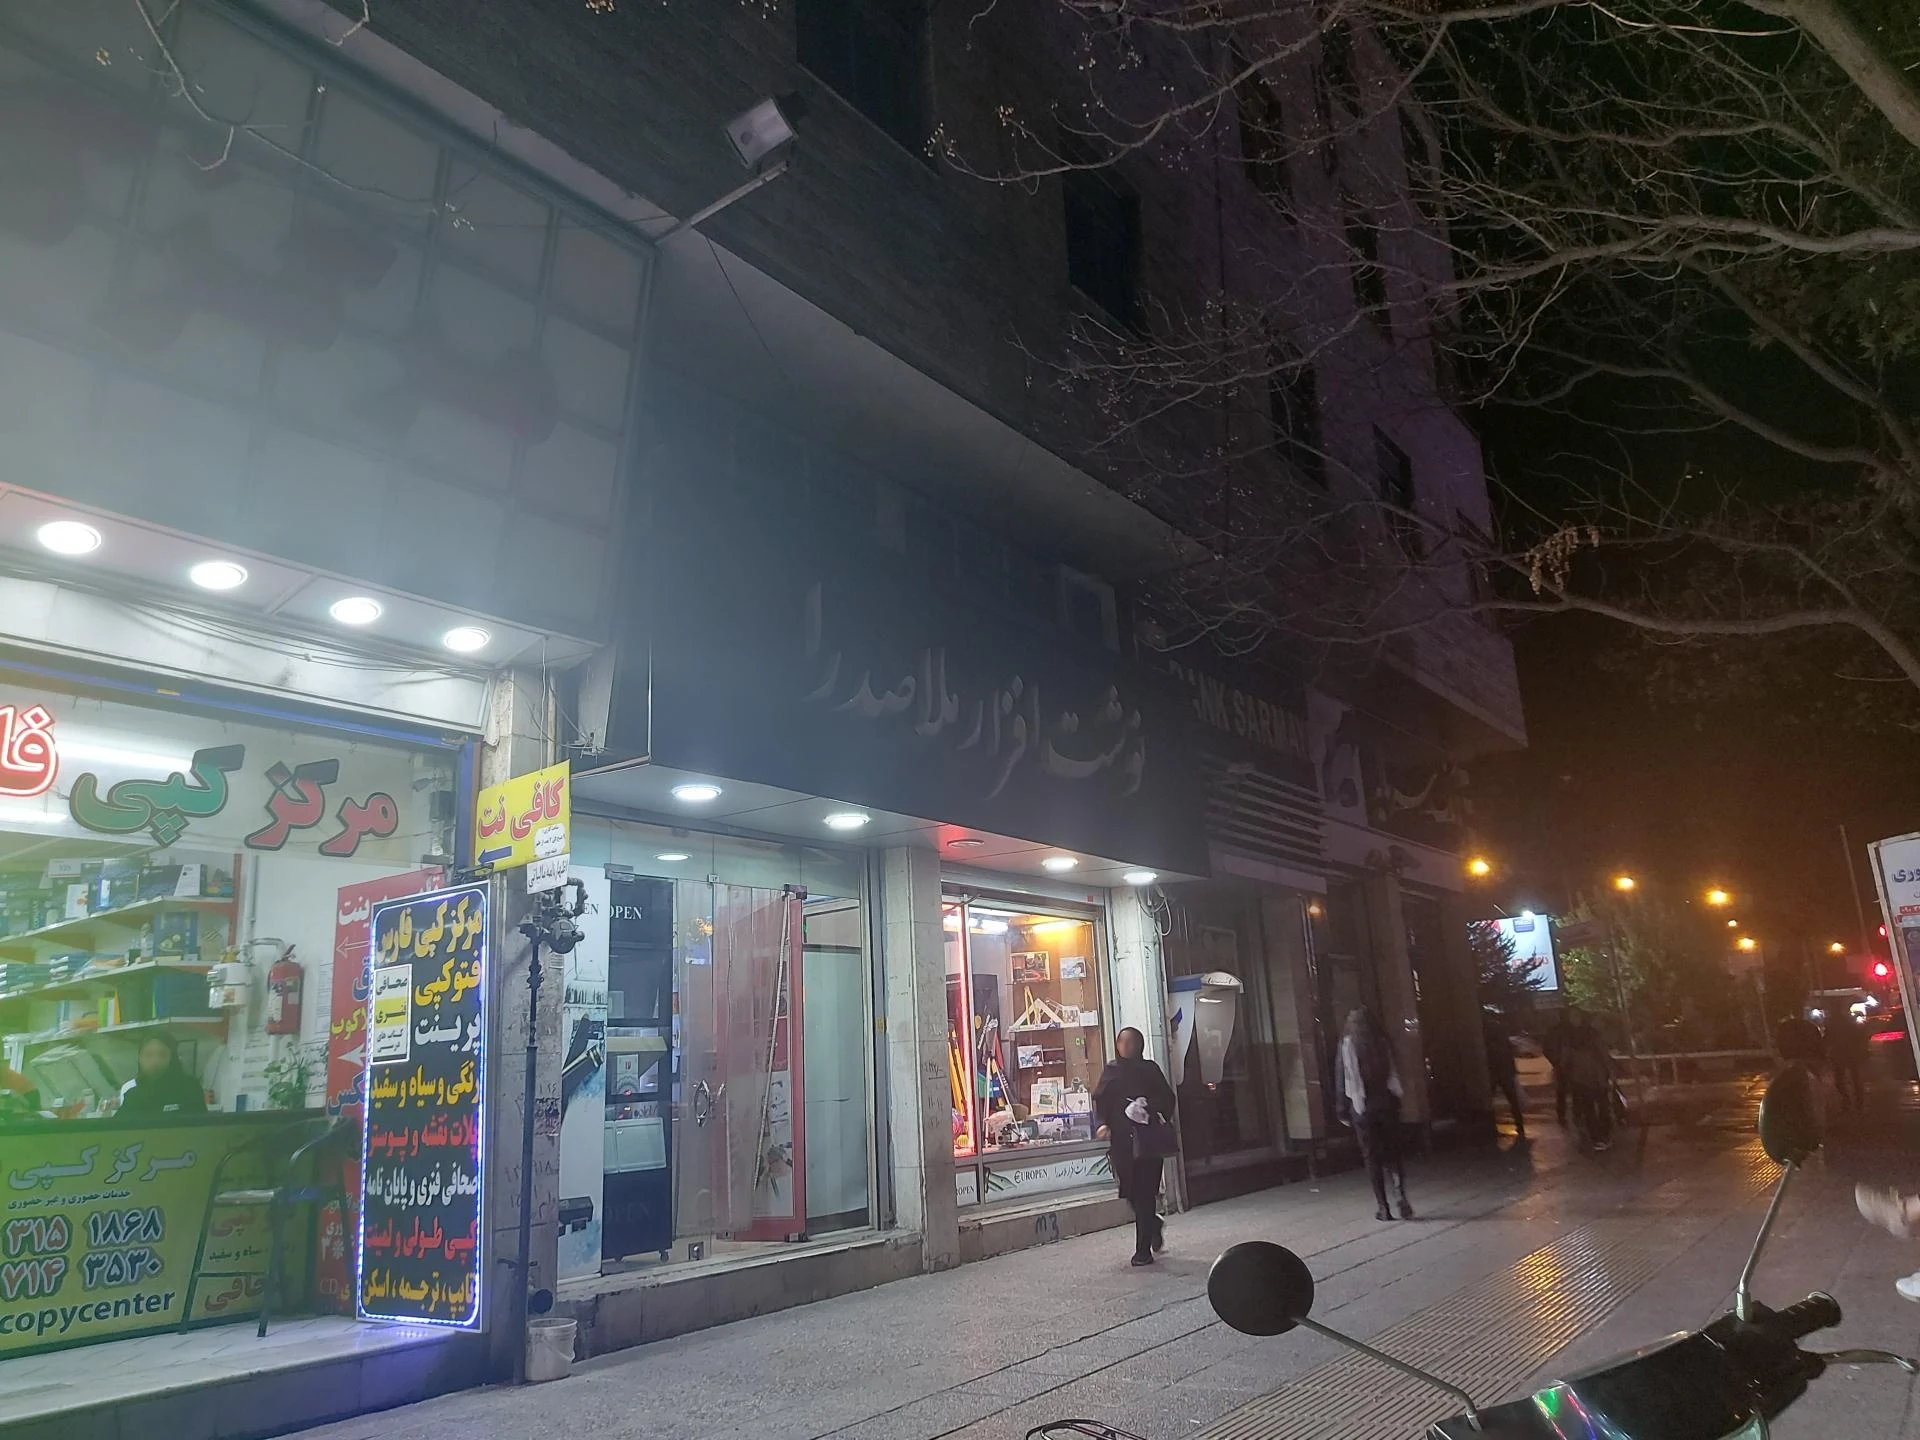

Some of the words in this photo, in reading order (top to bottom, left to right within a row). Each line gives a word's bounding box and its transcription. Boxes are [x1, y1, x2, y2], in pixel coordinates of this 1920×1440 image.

[802, 582, 960, 737] ملاصدرا
[69, 743, 246, 848] کپی
[244, 758, 399, 858] مرکز
[479, 794, 506, 839] نت
[510, 777, 565, 841] کافی
[376, 907, 412, 963] فارس
[415, 899, 448, 958] کپی
[447, 896, 482, 953] مرکز
[376, 976, 408, 996] صحافی
[415, 950, 481, 1010] فتوکپی
[414, 1013, 481, 1056] پرینت
[370, 1068, 398, 1109] سفید
[398, 1080, 407, 1108] و
[409, 1065, 436, 1107] سیاه
[436, 1076, 445, 1106] و
[447, 1060, 480, 1104] رنگی
[367, 1123, 409, 1162] پوستر
[410, 1129, 419, 1157] و
[421, 1112, 448, 1147] نقشه
[450, 1113, 479, 1161] پلات
[8, 1144, 100, 1191] کپی
[103, 1141, 198, 1185] مرکز
[366, 1166, 384, 1197] نامه
[417, 1161, 442, 1206] فنری
[442, 1161, 478, 1206] صحافی
[384, 1166, 408, 1211] پایان
[408, 1179, 415, 1206] و
[5, 1214, 70, 1256] ۳۱۵
[87, 1206, 164, 1247] ۱۸۶۸
[365, 1217, 393, 1257] لمینت
[394, 1231, 401, 1258] و
[403, 1215, 443, 1259] طولی
[445, 1218, 478, 1266] کپی
[0, 1256, 67, 1300] ۷۱۴
[82, 1247, 163, 1289] ۳۵۳۰
[363, 1267, 390, 1307] اسکن
[0, 1291, 176, 1337] copycenter
